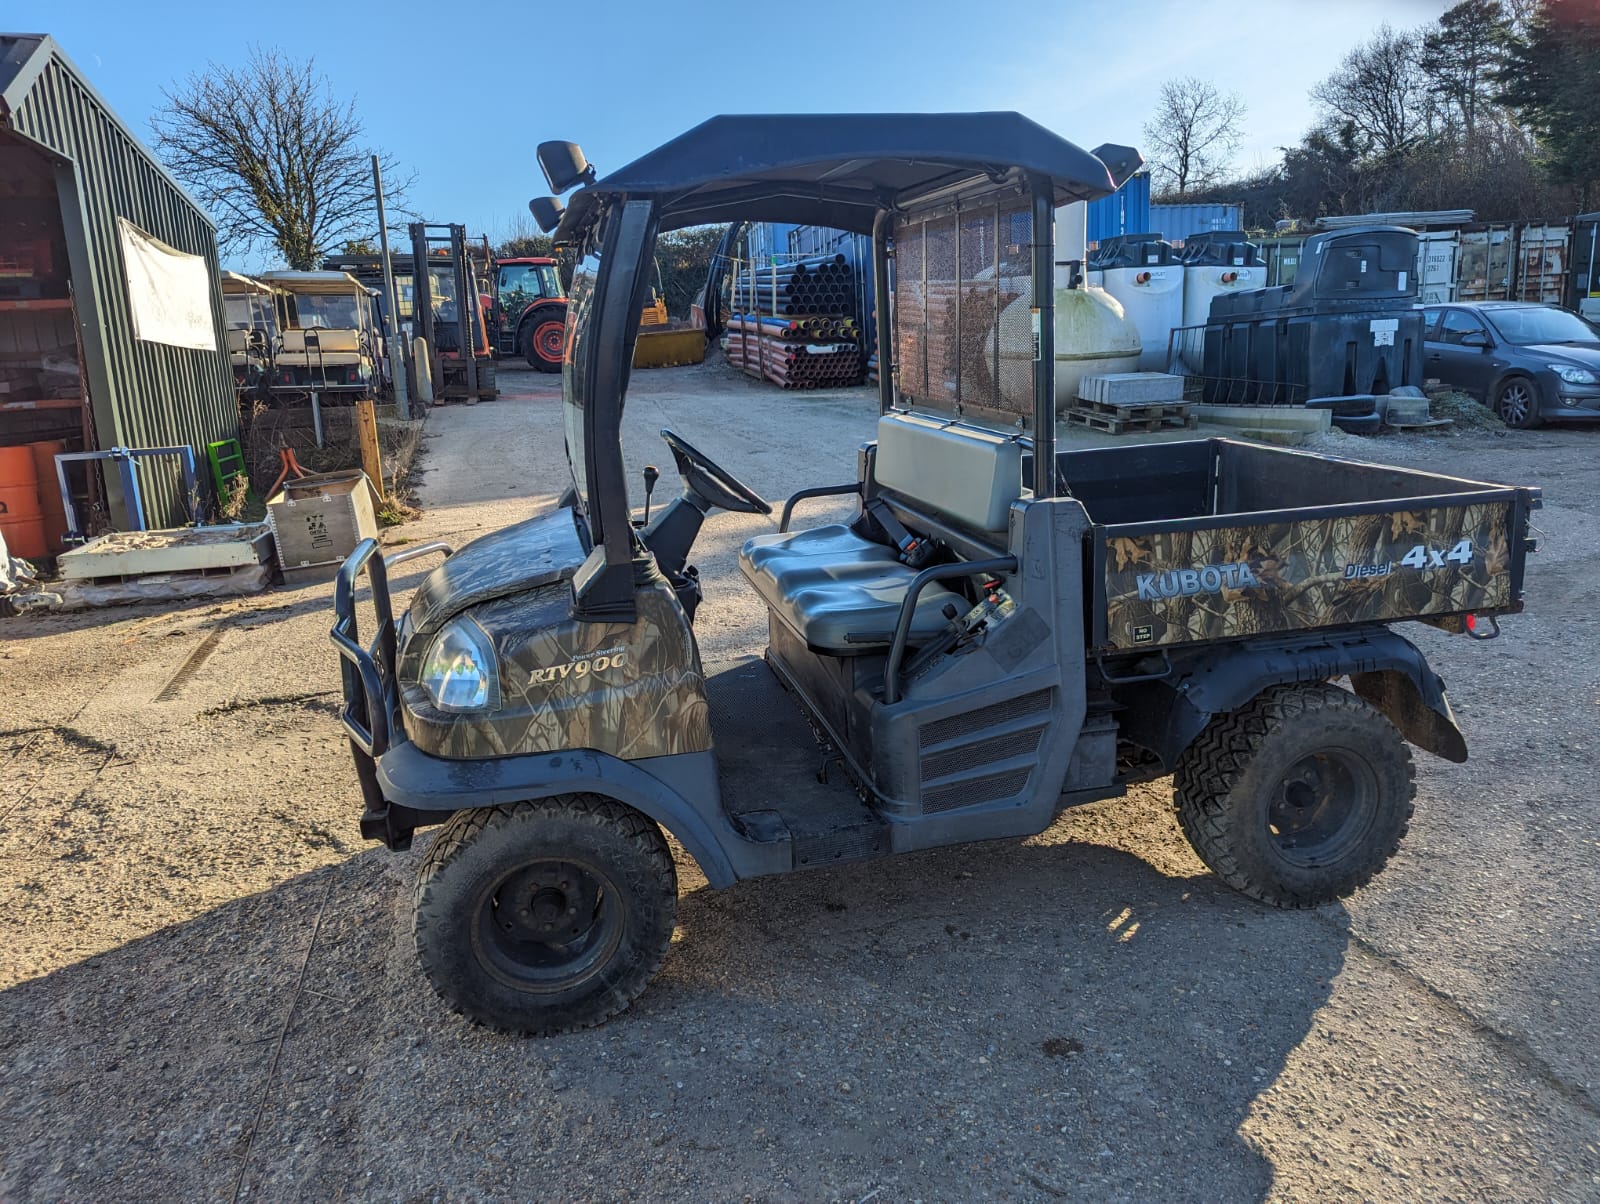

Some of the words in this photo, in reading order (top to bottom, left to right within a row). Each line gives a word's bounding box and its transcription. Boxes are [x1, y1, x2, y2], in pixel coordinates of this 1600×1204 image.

[1345, 560, 1392, 580] Diesel
[1400, 540, 1473, 569] 4x4
[1136, 562, 1257, 600] KUBOTA
[527, 652, 628, 685] RTV900
[571, 652, 593, 661] Power
[595, 646, 625, 656] Steering
